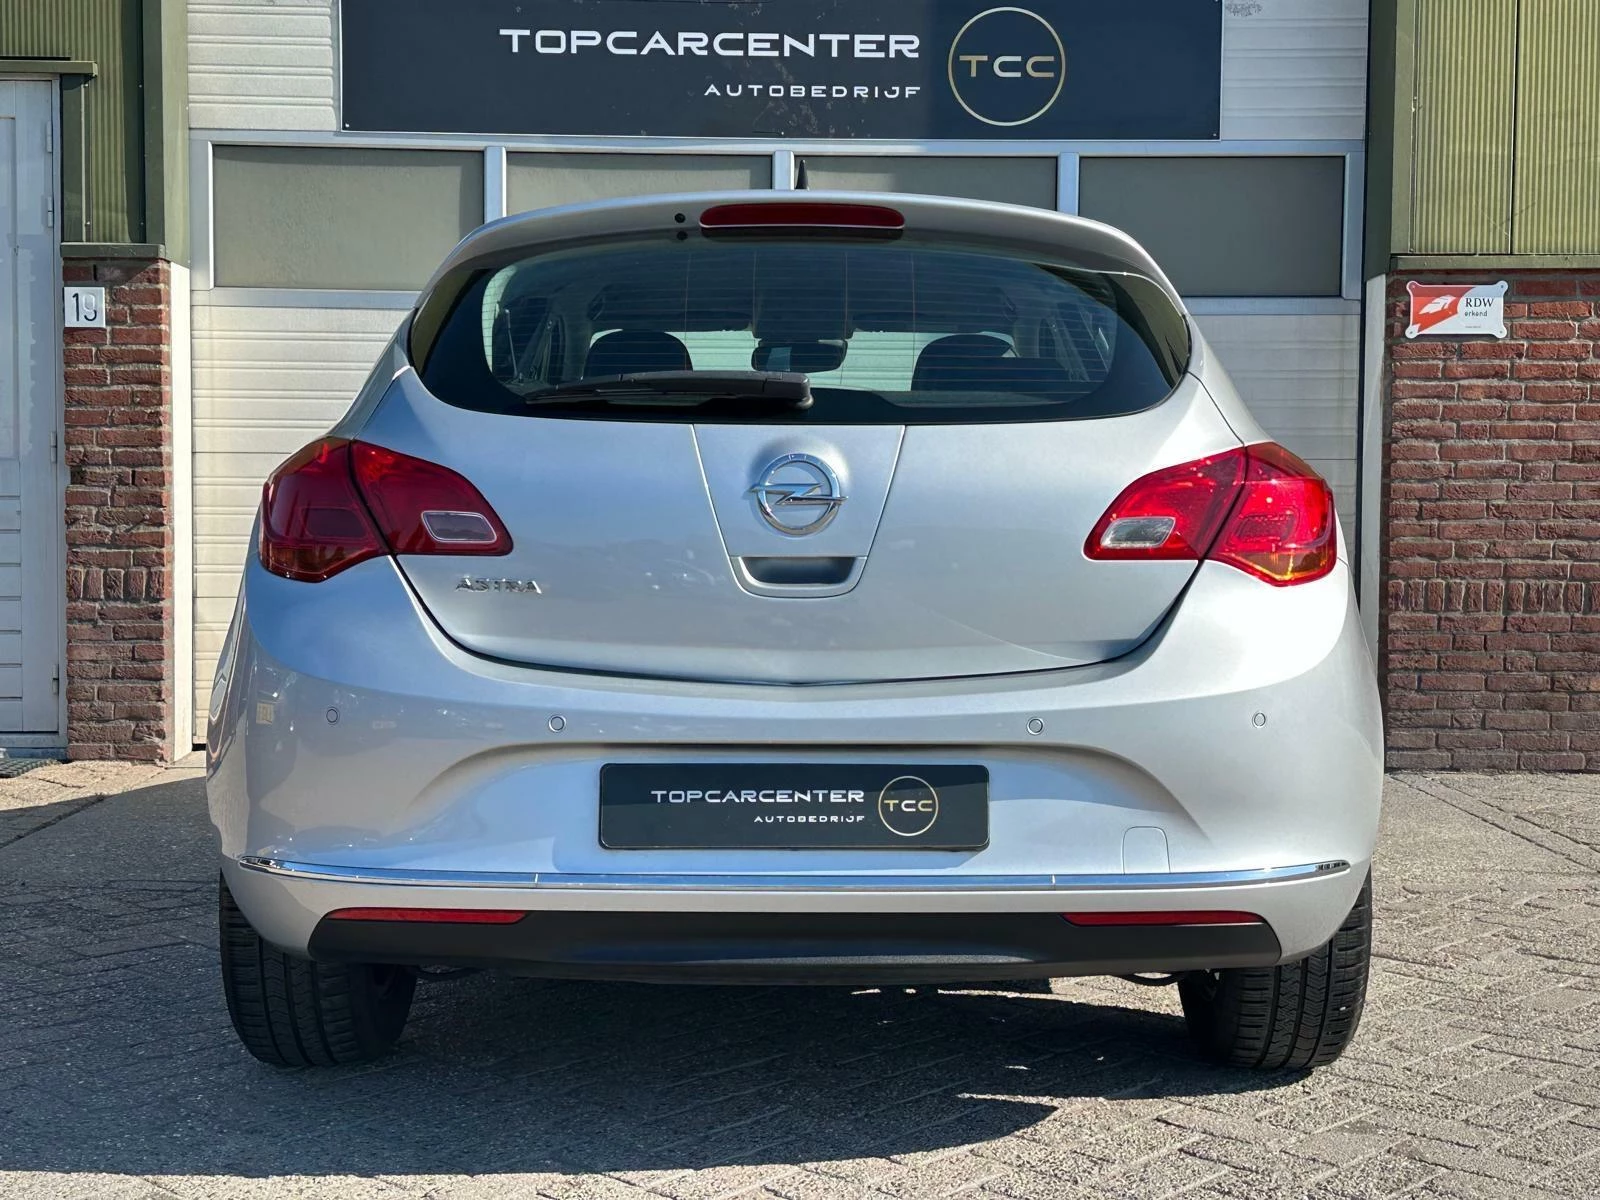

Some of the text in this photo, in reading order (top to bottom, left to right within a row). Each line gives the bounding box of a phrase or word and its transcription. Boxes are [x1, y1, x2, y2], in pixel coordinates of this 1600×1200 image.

[499, 28, 920, 59] TOPCARCENTER
[959, 55, 1056, 78] TCC
[703, 83, 921, 99] AUTOBEDRIJF
[72, 292, 97, 322] 19
[1465, 297, 1494, 308] RDW
[455, 576, 542, 594] ASTRA
[650, 789, 865, 804] TOPCARCENTER
[883, 799, 934, 812] TCC
[753, 815, 866, 824] AUTOBEDRIJF
